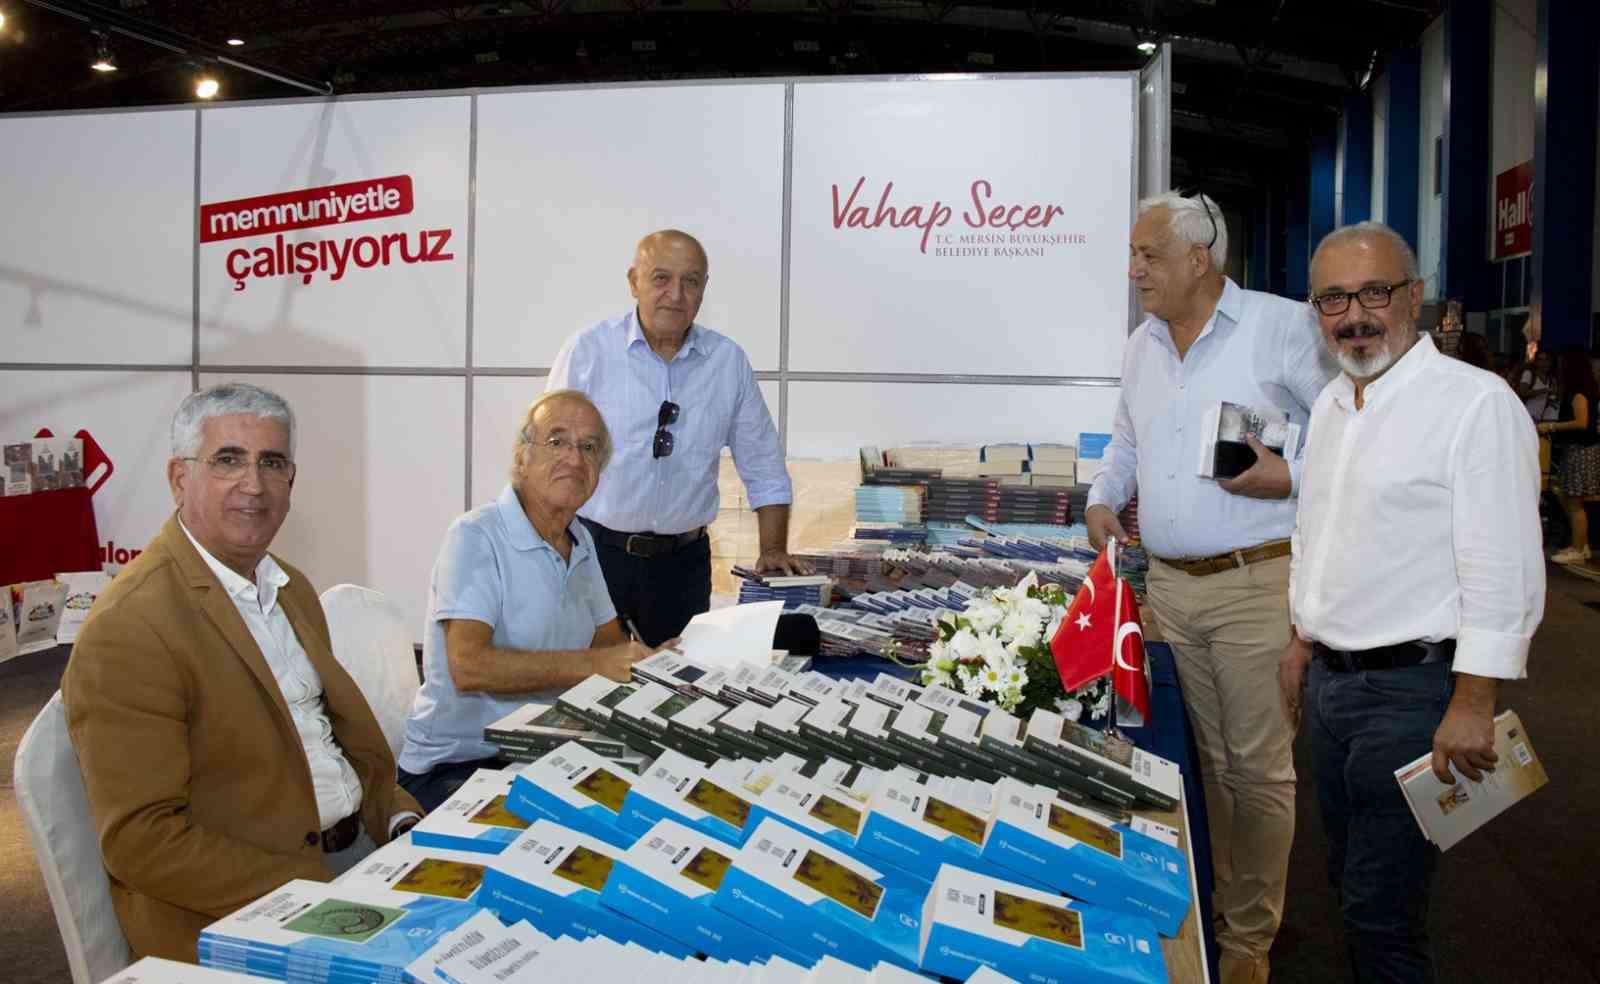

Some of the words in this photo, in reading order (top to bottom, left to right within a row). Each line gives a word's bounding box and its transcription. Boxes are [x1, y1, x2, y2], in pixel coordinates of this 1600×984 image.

[210, 184, 401, 234] memnuniyetle
[831, 176, 953, 254] Vahap
[962, 180, 1065, 232] Seçer
[1498, 191, 1526, 232] Hall
[226, 228, 454, 291] çalışıyoruz
